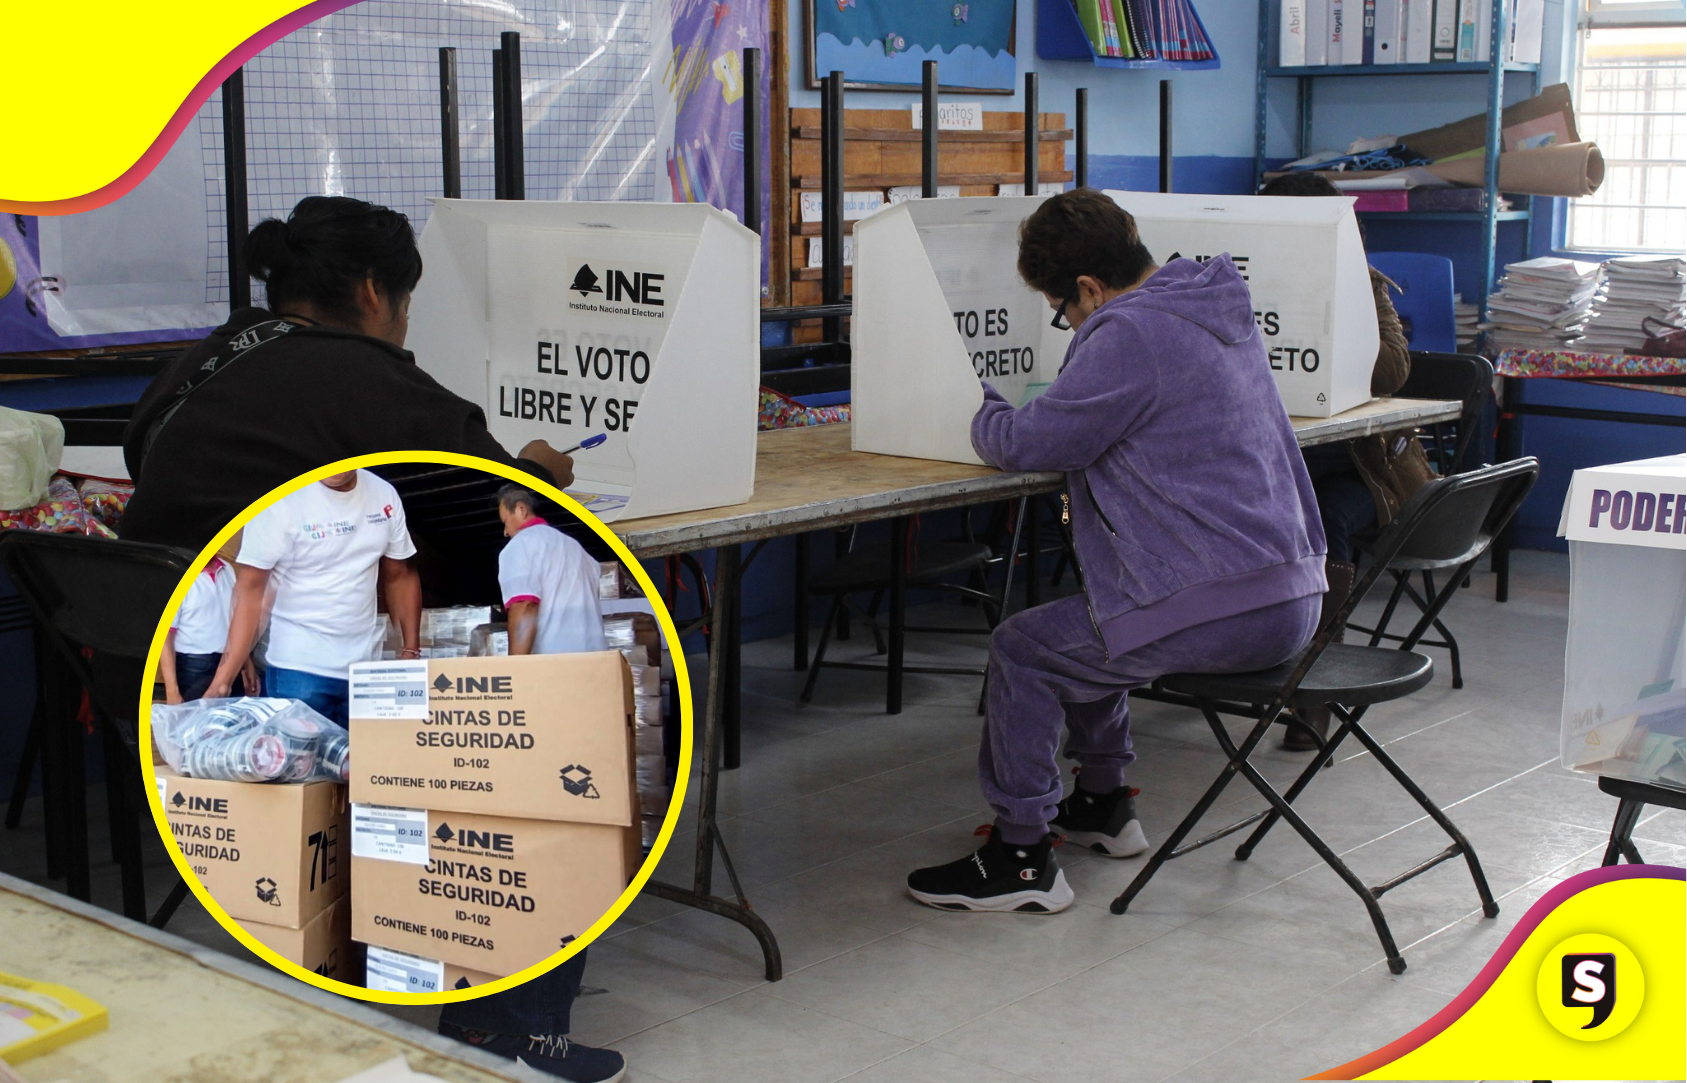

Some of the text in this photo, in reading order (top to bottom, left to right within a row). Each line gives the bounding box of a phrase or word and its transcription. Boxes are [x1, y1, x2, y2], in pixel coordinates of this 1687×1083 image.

[1289, 6, 1300, 34] Abril
[1332, 9, 1343, 43] Mayeli
[606, 269, 664, 306] INE
[569, 302, 664, 318] Instituto Nacional Electoral
[985, 308, 1008, 336] ES
[537, 341, 650, 384] EL VOTO
[969, 346, 1033, 378] CRETO
[499, 385, 572, 425] LIBRE
[579, 394, 598, 428] Y
[457, 676, 512, 693] INE
[498, 710, 526, 726] DE
[416, 732, 534, 749] SEGURIDAD
[453, 757, 490, 768] ID-102
[370, 775, 493, 792] CONTIENE 100 PIEZAS
[189, 796, 228, 813] INE
[169, 822, 236, 842] INTAS DE
[410, 829, 423, 837] 102
[458, 829, 514, 853] INE
[177, 841, 240, 862] GURIDAD
[431, 844, 514, 860] Instituto Nacional Electoral
[499, 869, 527, 888] DE
[418, 879, 536, 913] SEGURIDAD
[455, 910, 491, 926] ID-102
[374, 915, 494, 950] CONTIENE 100 PIEZAS
[409, 976, 435, 989] ID: 102
